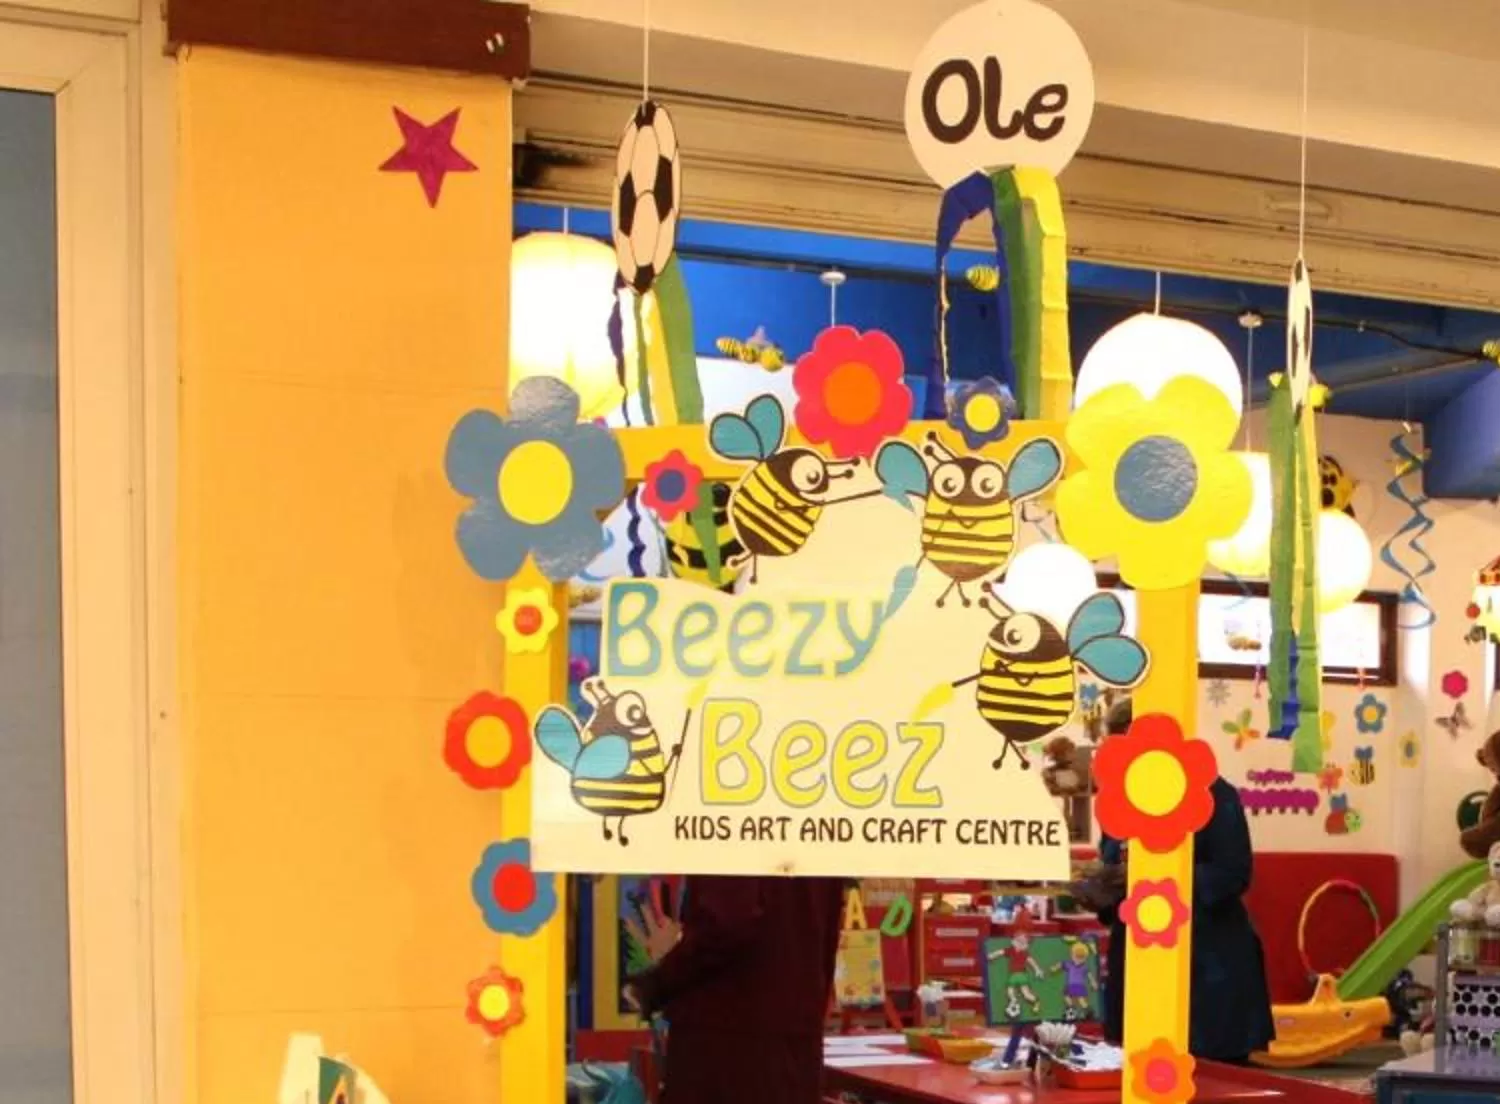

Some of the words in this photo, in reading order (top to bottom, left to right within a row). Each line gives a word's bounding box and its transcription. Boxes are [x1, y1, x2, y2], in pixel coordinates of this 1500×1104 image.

[604, 581, 891, 679] Beezy
[700, 696, 945, 809] Beez
[674, 815, 732, 841] KIDS
[739, 816, 793, 842] ART
[800, 817, 856, 844] AND
[862, 817, 948, 846] CRAFT
[955, 819, 1062, 848] CENTRE
